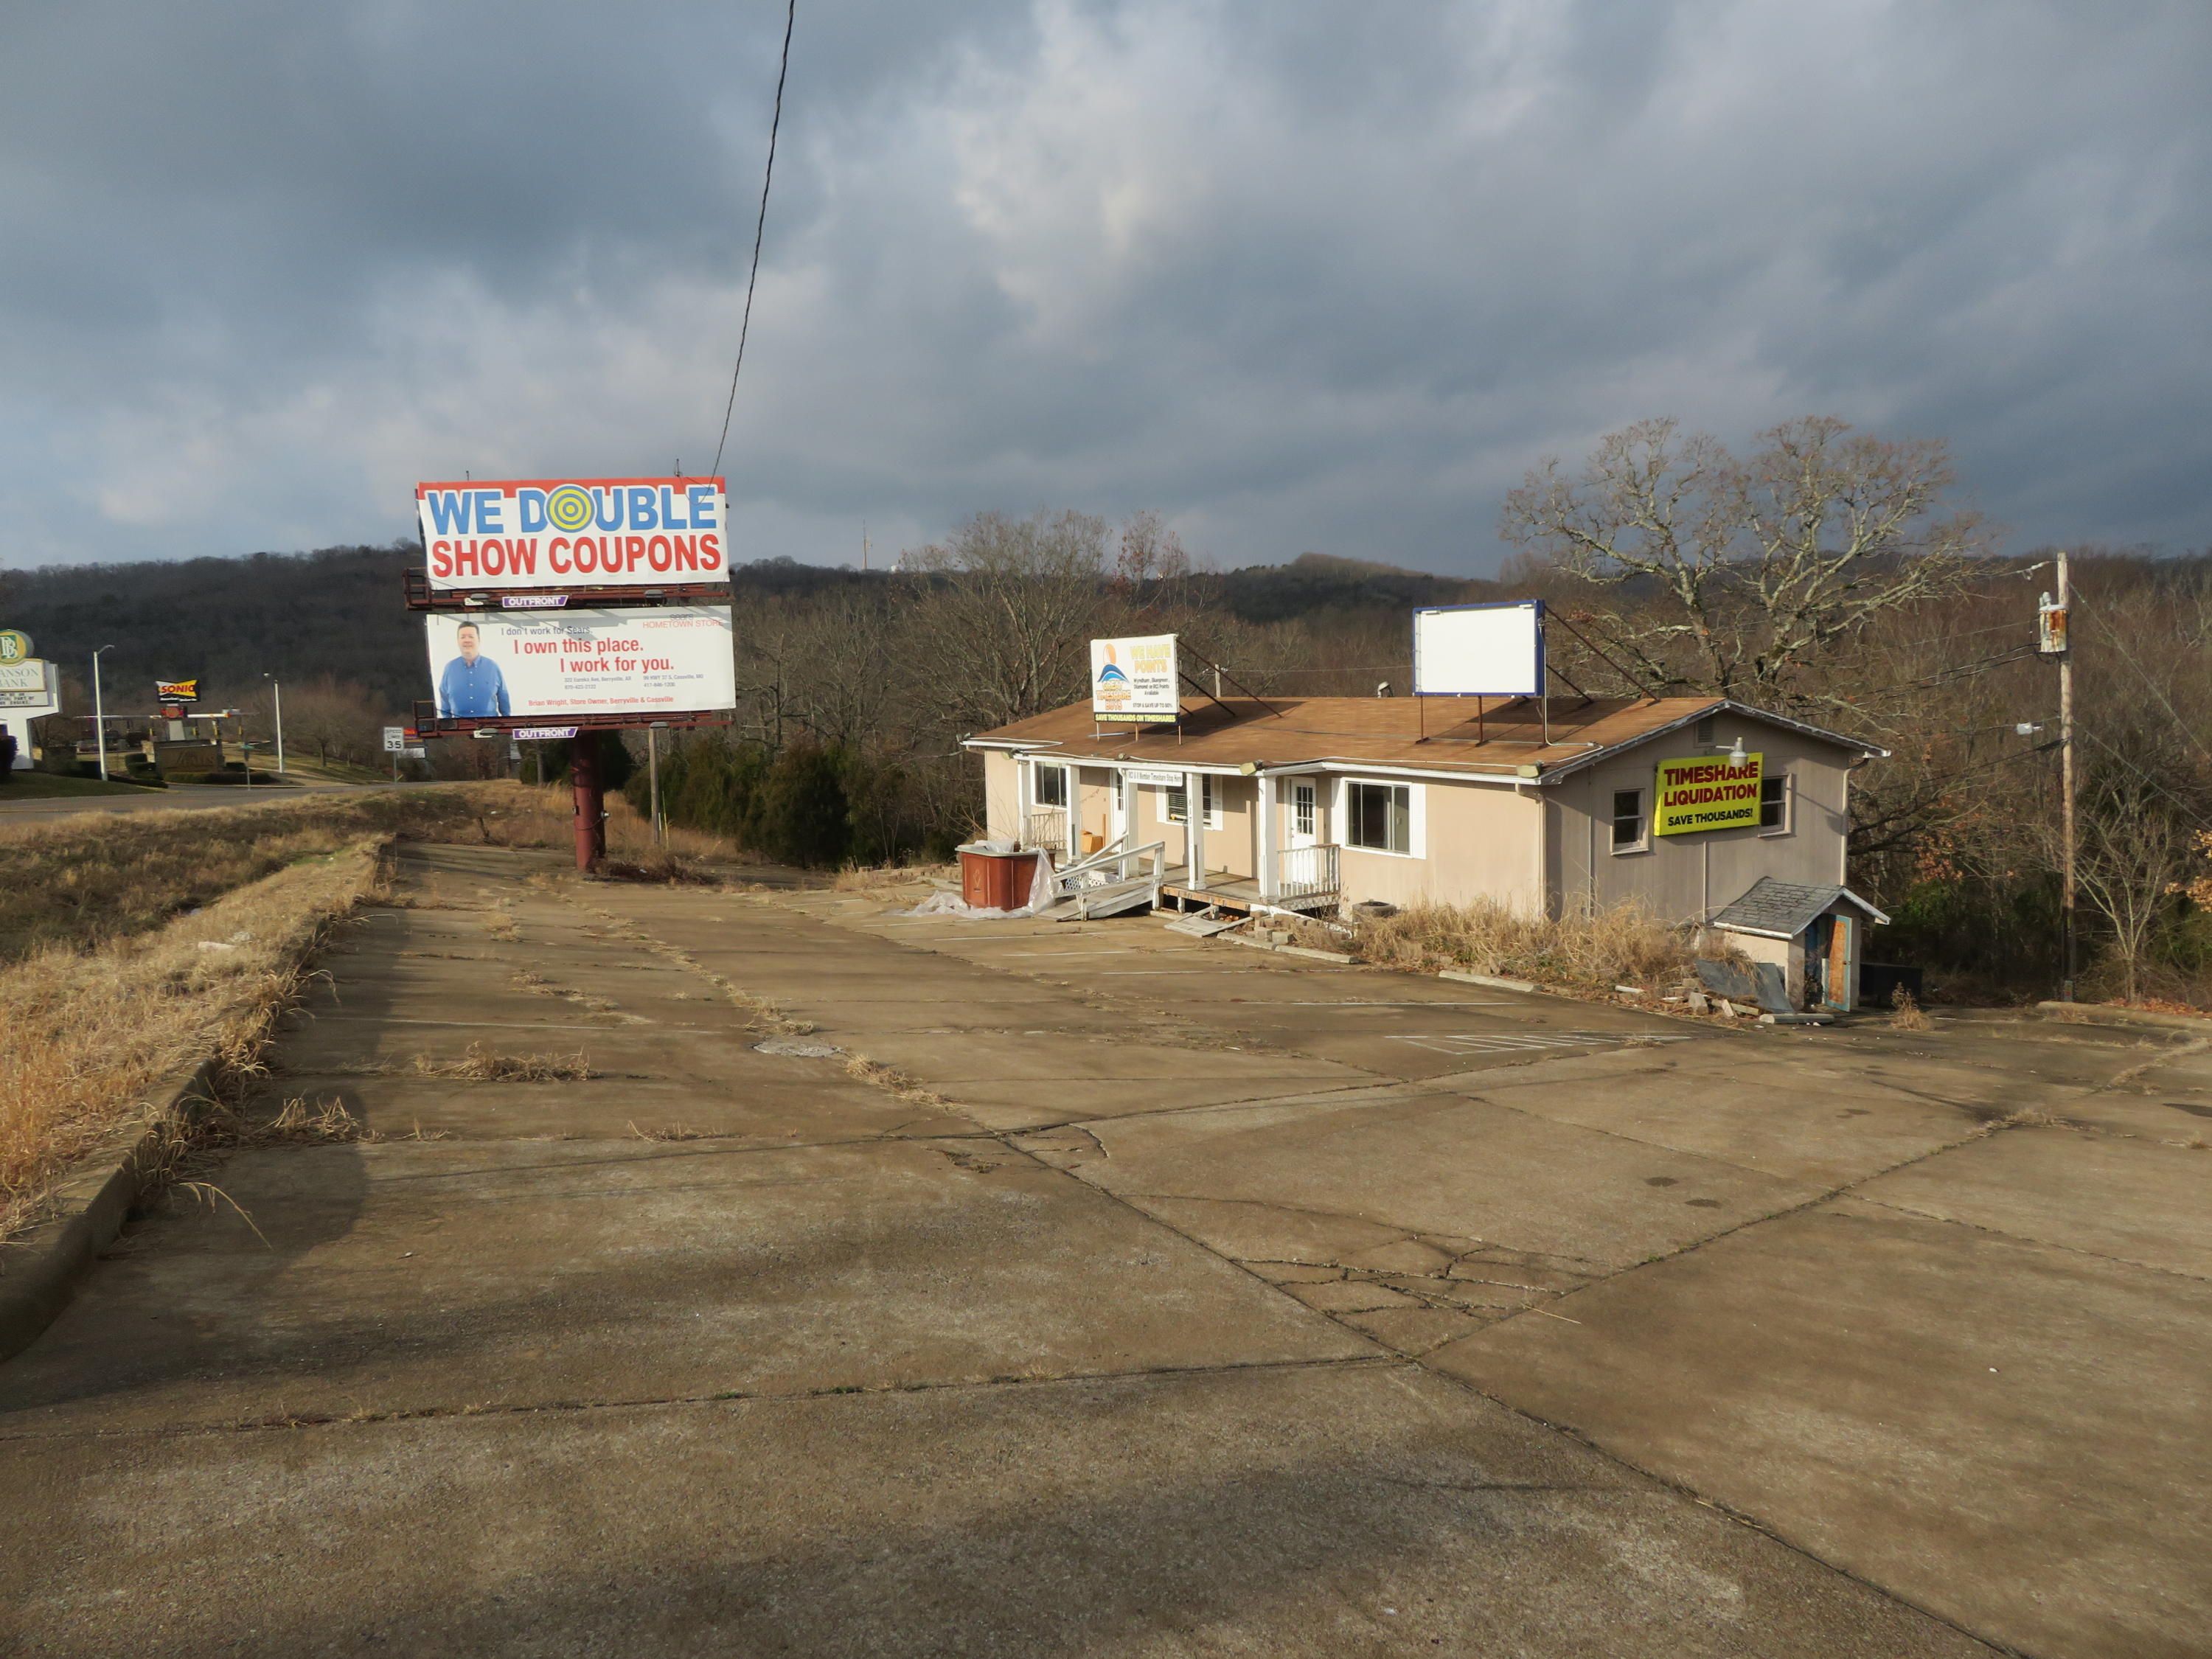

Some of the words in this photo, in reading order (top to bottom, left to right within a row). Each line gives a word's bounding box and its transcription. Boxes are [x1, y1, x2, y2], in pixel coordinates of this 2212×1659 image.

[428, 491, 504, 535] WE
[518, 484, 717, 534] DOUBLE
[432, 538, 538, 577] SHOW
[549, 534, 721, 574] COUPONS
[509, 597, 561, 605] OUTFRONT
[507, 627, 529, 636] don't
[530, 626, 551, 635] work
[553, 625, 564, 635] for
[566, 625, 593, 635] Sears.
[643, 620, 693, 629] HOMETOWN
[695, 619, 723, 627] STORE
[514, 640, 518, 654] I
[524, 643, 557, 654] own
[562, 638, 591, 653] this
[597, 638, 644, 655] place.
[560, 658, 565, 672] I
[570, 657, 611, 672] work
[615, 657, 639, 672] for
[642, 658, 675, 674] you.
[1134, 658, 1167, 673] POINTS
[161, 684, 195, 693] SONIC
[546, 698, 568, 707] Wright,
[570, 698, 586, 706] Store
[610, 696, 639, 706] Berryville
[1095, 713, 1108, 721] SAVE
[1108, 714, 1135, 722] THOUSANDS
[1136, 714, 1144, 722] ON
[1144, 714, 1177, 723] TIMESHARES
[518, 729, 571, 738] OUTFRONT
[387, 740, 401, 748] 35
[1663, 762, 1759, 786] TIMESHARE
[1664, 783, 1757, 807] LIQUIDATION
[1668, 815, 1693, 827] SAVE
[1696, 808, 1753, 824] THOUSANDS!
